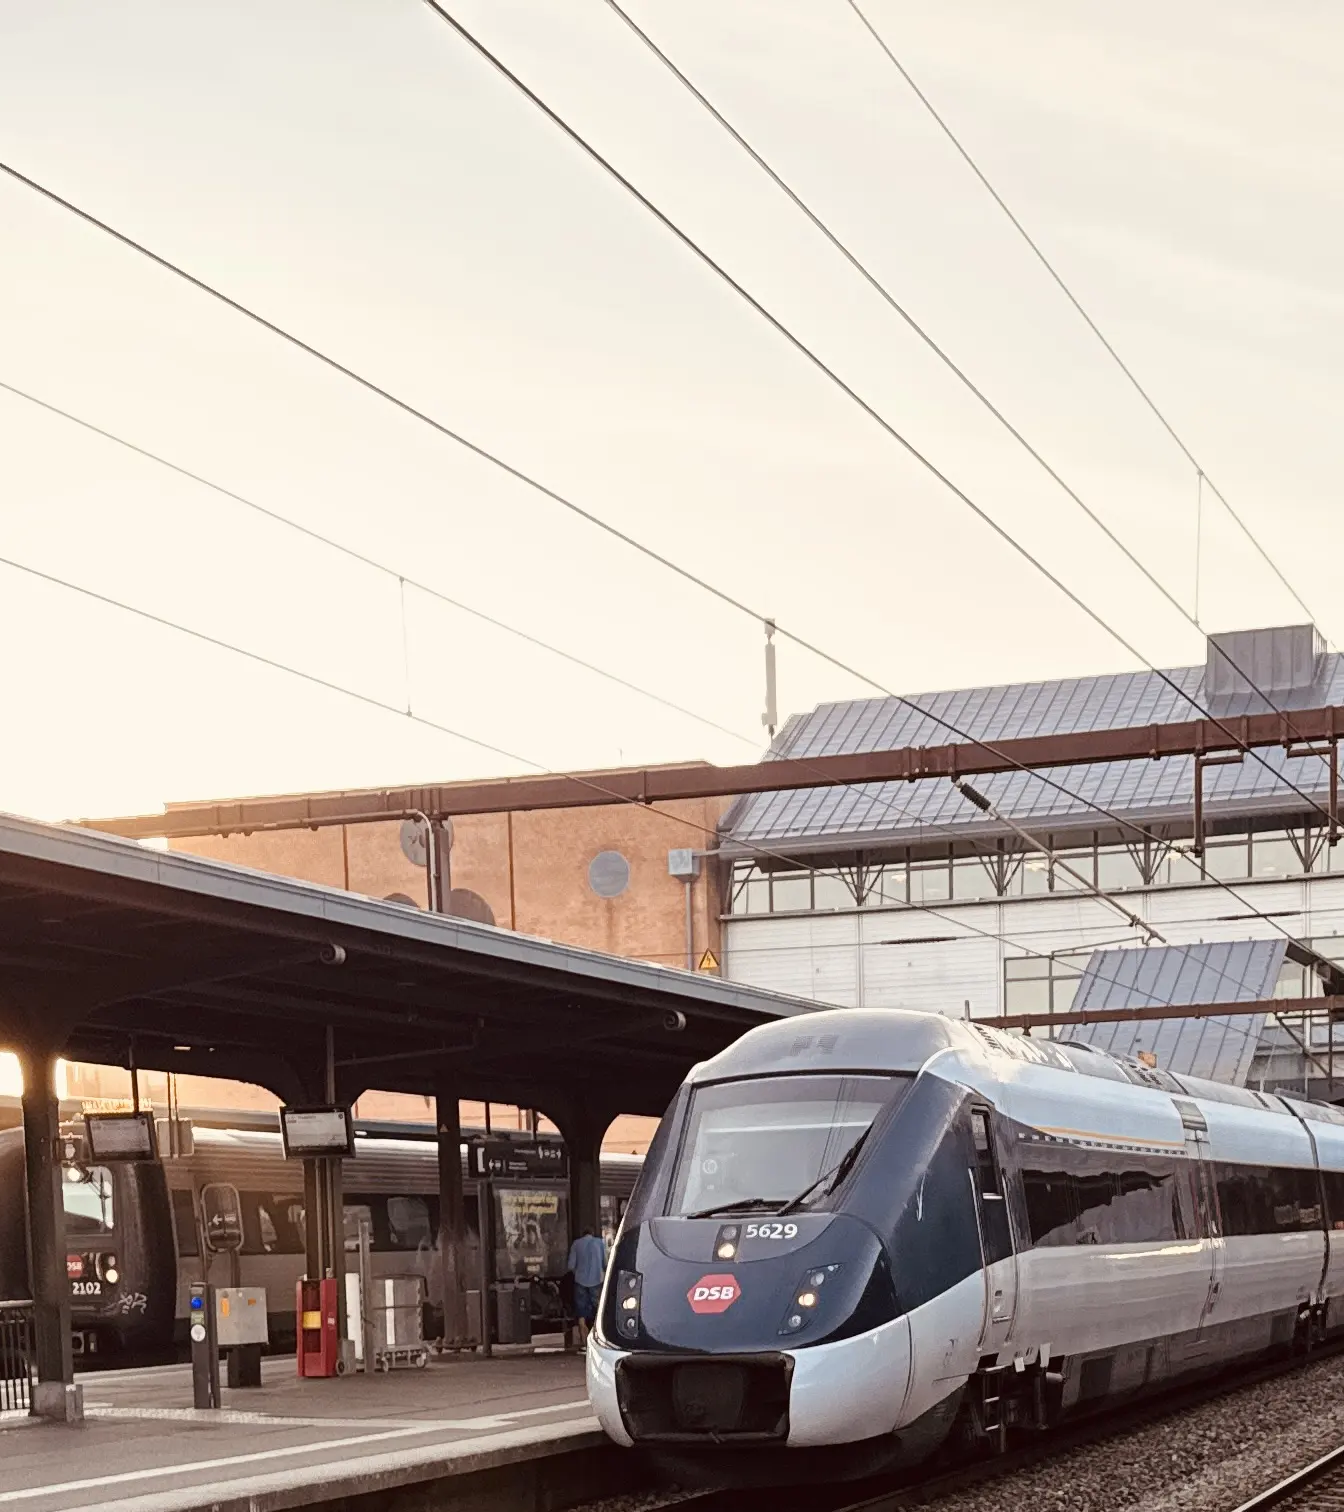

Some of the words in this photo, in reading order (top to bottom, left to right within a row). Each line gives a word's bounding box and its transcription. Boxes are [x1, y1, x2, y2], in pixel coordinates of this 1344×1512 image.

[745, 1223, 798, 1239] 5629
[72, 1281, 101, 1295] 2102
[693, 1286, 734, 1301] DSB
